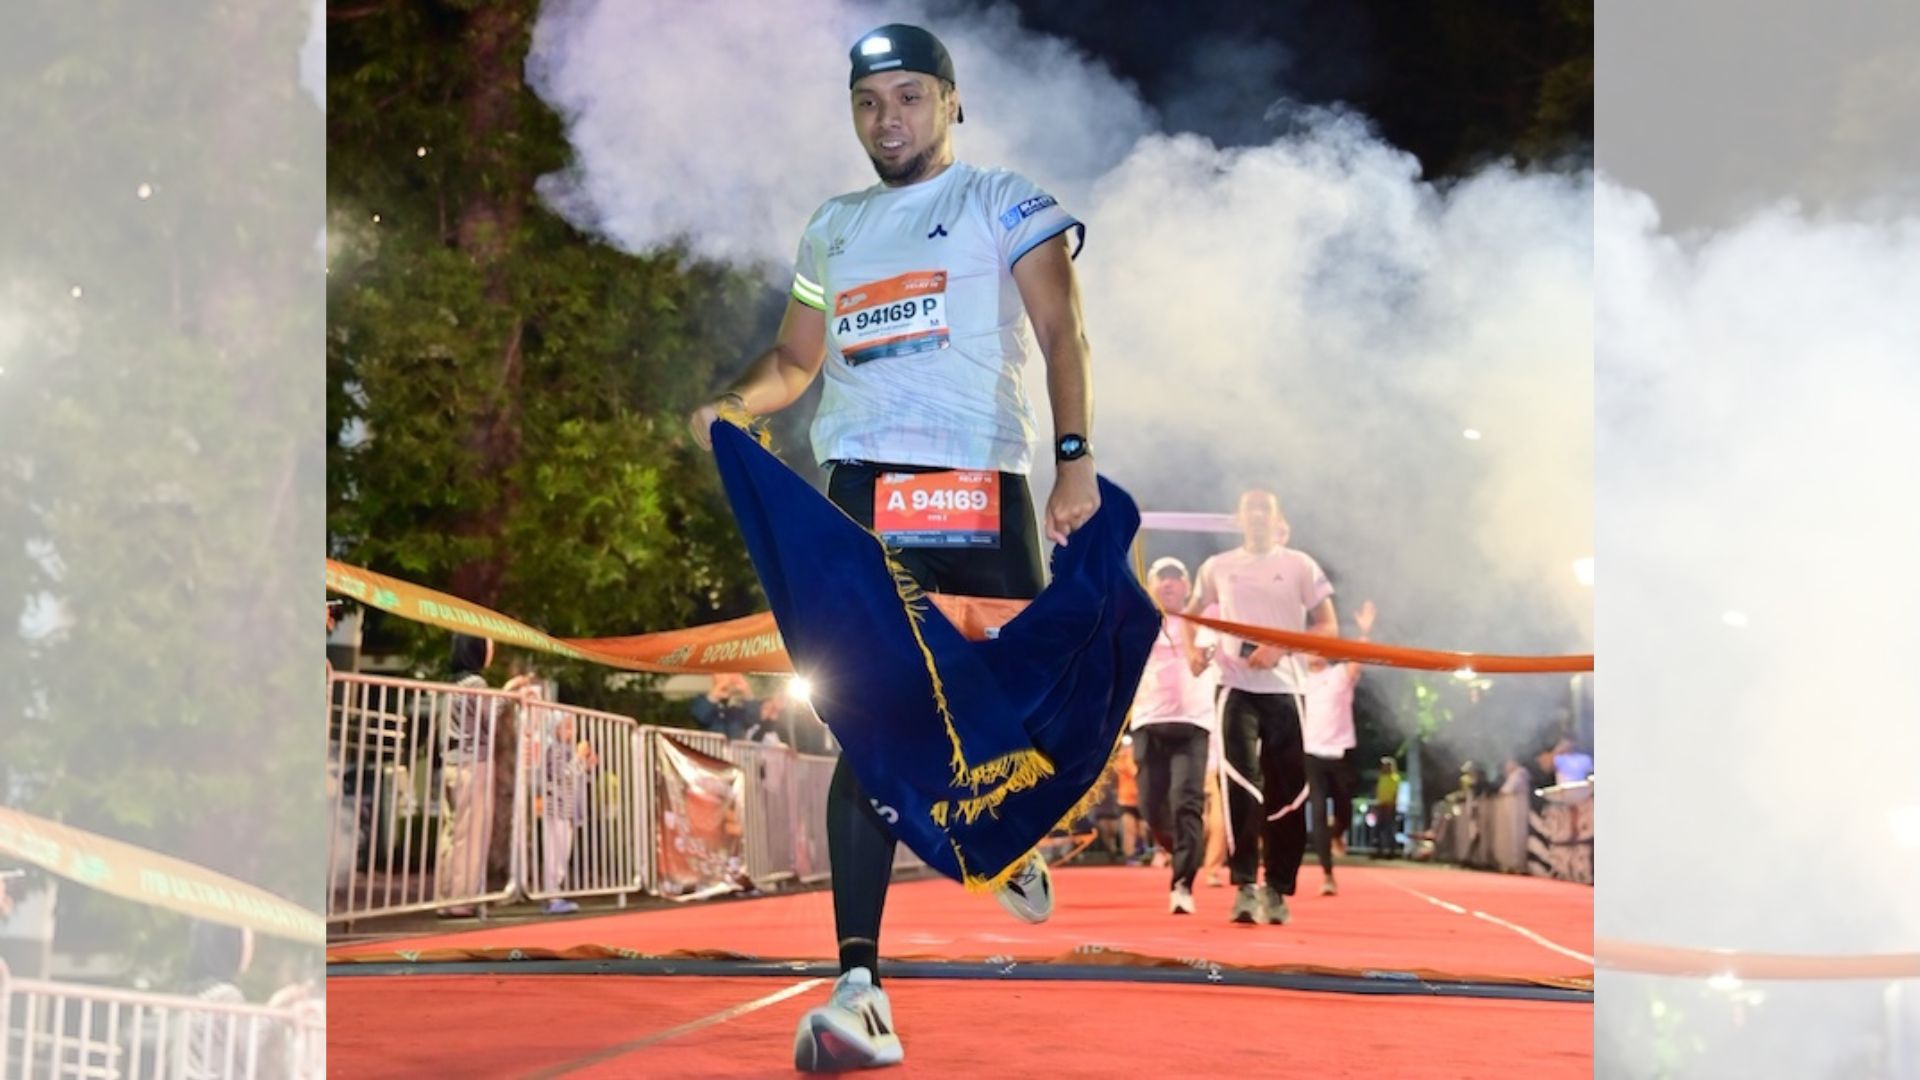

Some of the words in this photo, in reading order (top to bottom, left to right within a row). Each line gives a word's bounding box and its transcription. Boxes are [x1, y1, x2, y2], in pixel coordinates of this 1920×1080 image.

[837, 317, 851, 335] A
[856, 301, 917, 330] 94169
[922, 298, 937, 316] P
[886, 489, 907, 511] A
[911, 489, 988, 511] 94169
[701, 640, 739, 664] 2026
